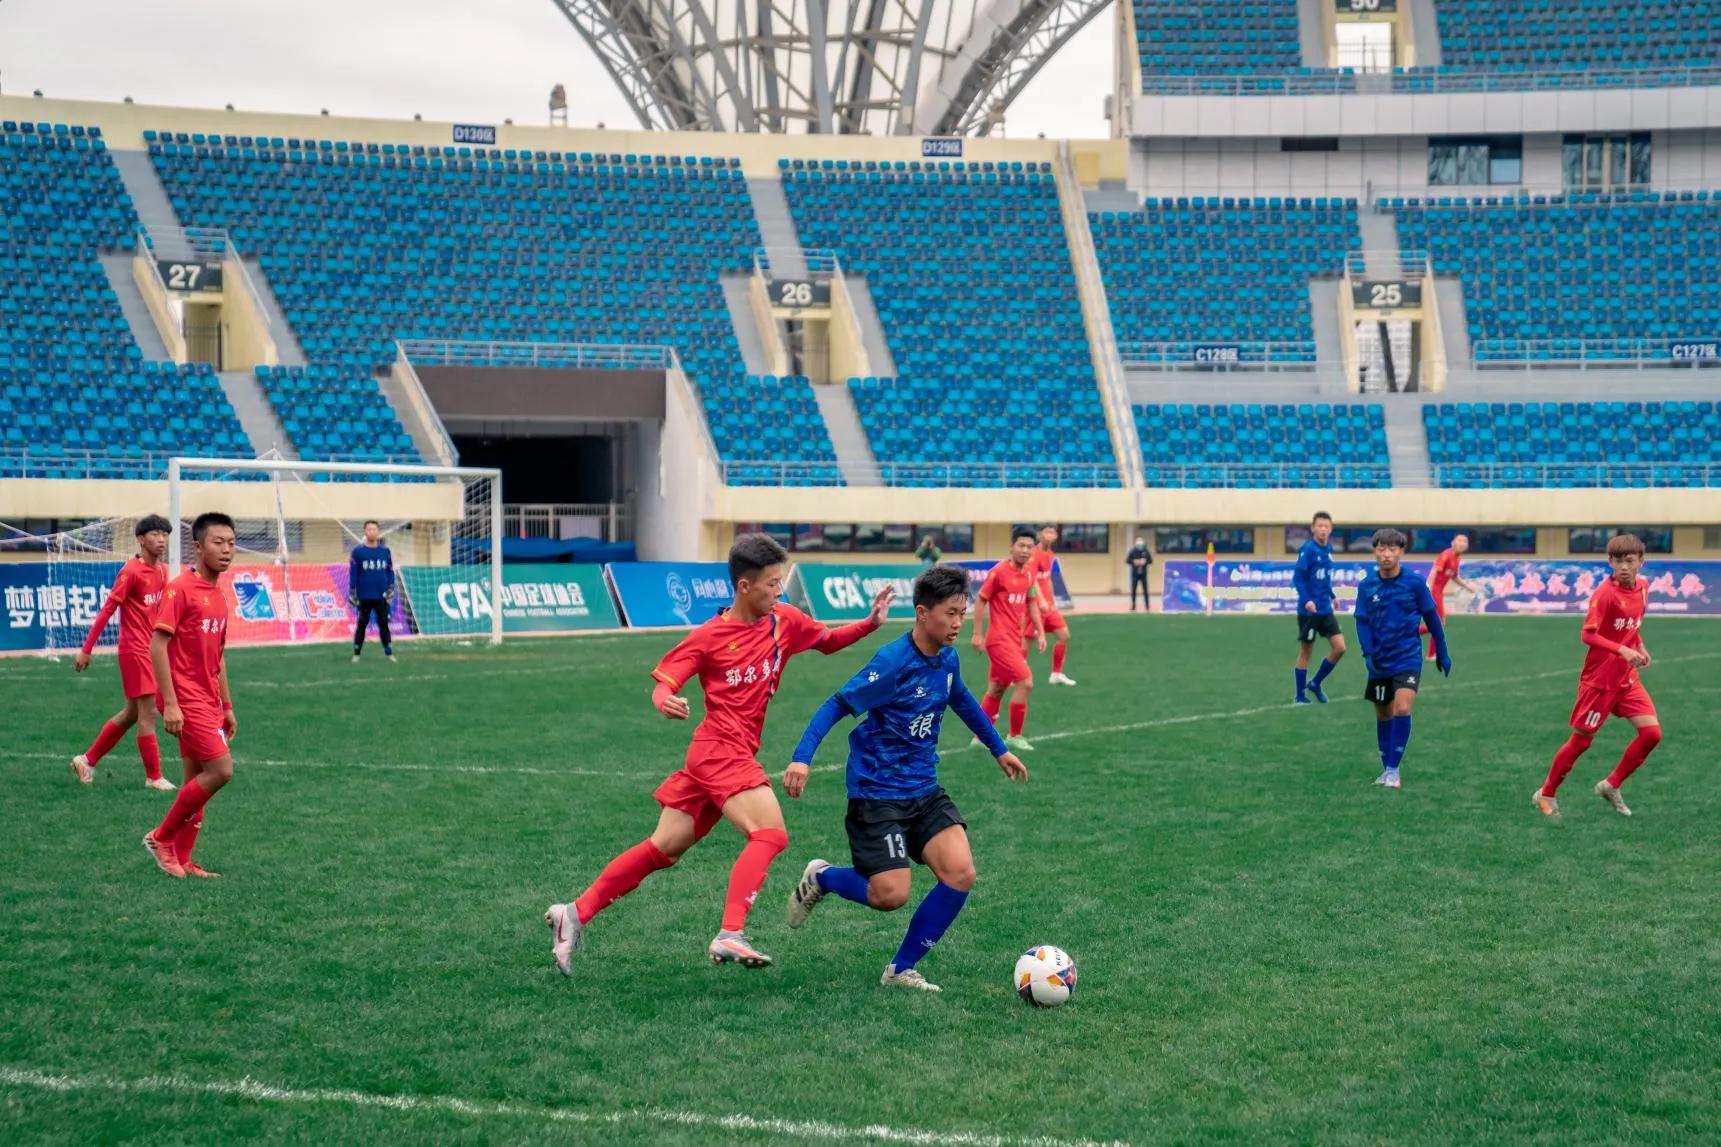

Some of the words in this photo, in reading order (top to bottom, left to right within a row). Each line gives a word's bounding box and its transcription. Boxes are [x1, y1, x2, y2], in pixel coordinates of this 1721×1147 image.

[168, 264, 201, 289] 27
[781, 282, 813, 305] 26
[1371, 284, 1402, 307] 25
[437, 582, 494, 620] CFA
[822, 576, 867, 609] CFA
[1375, 685, 1386, 701] 11
[1584, 709, 1601, 728] 10
[884, 833, 906, 858] 13
